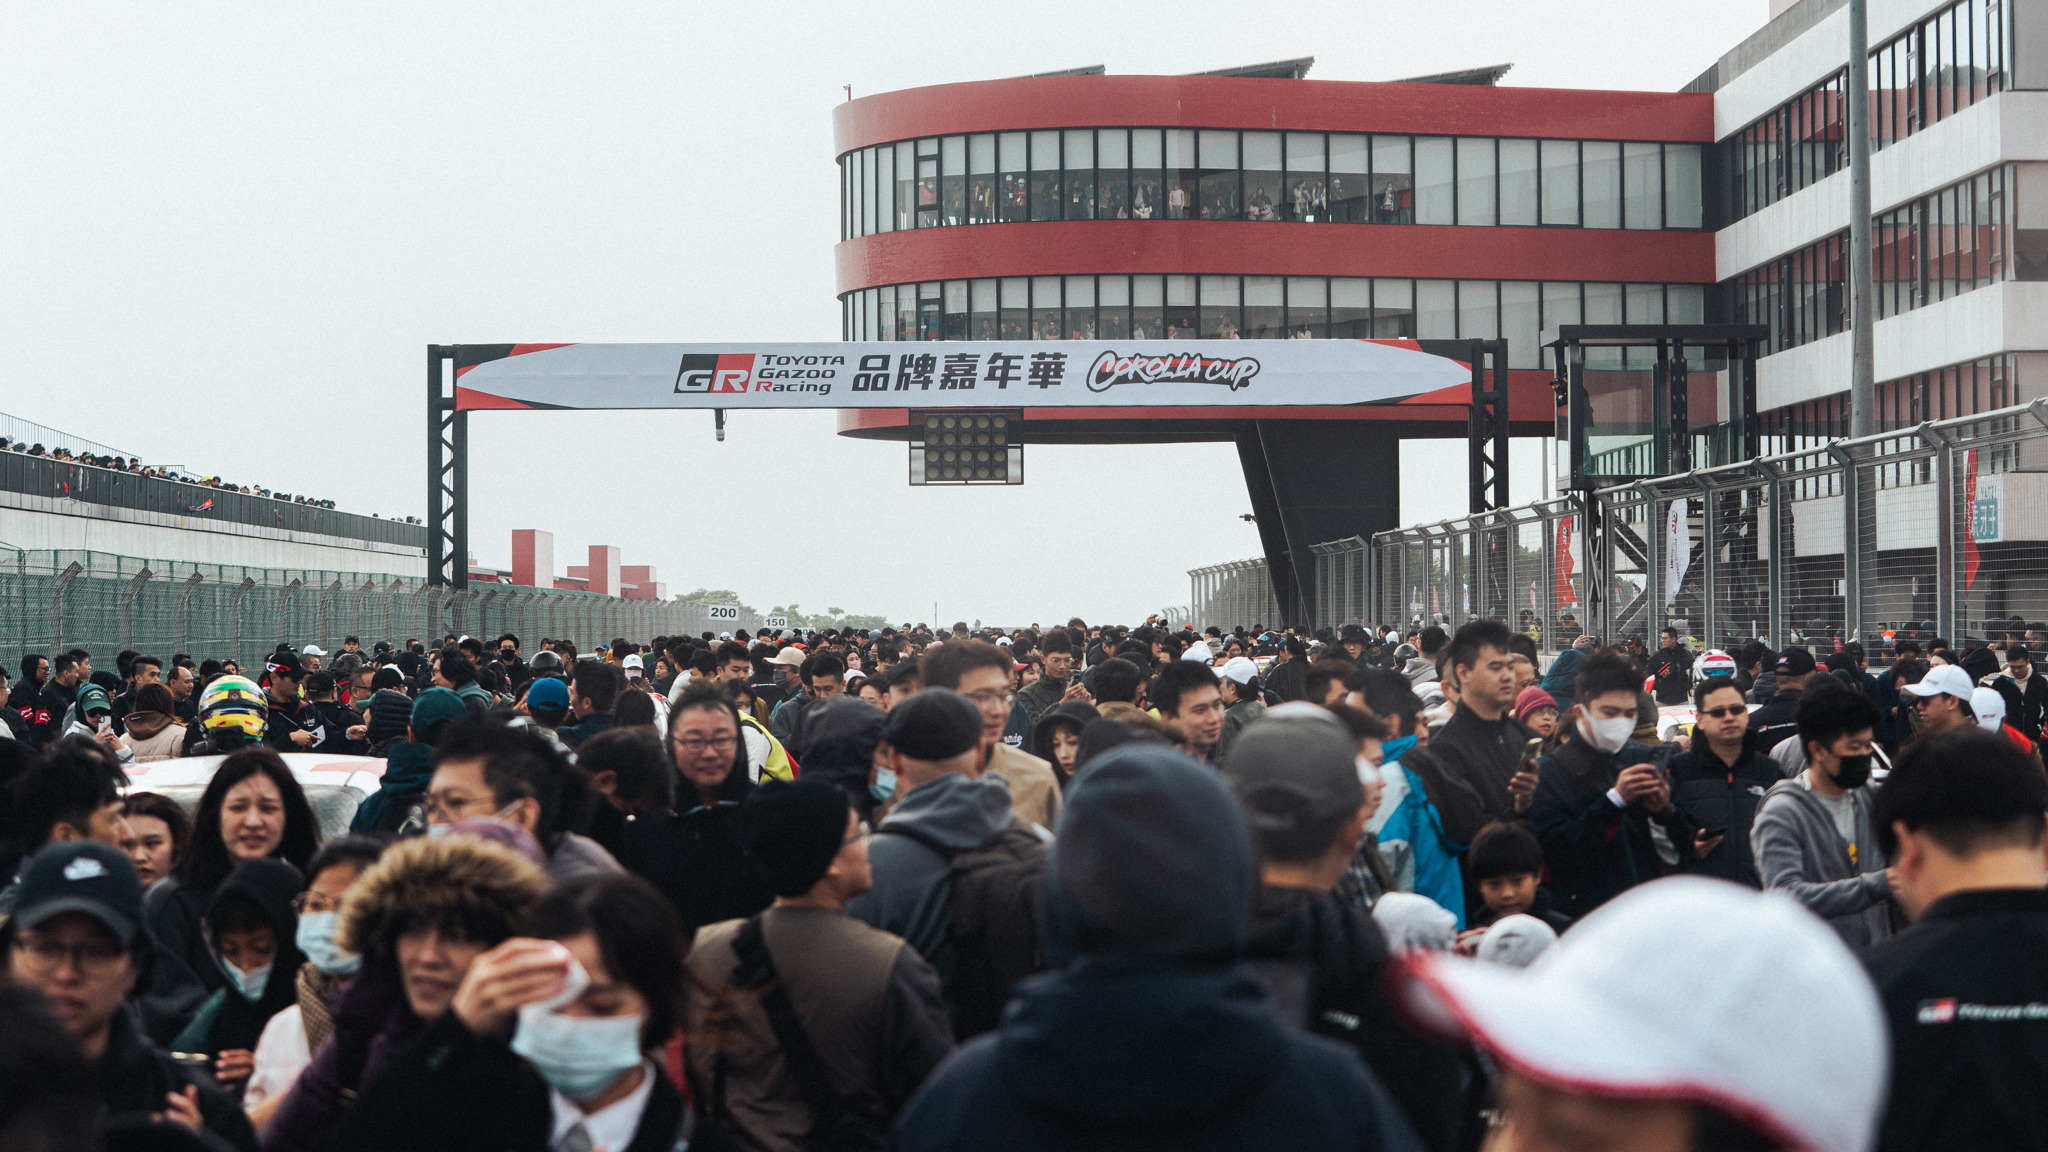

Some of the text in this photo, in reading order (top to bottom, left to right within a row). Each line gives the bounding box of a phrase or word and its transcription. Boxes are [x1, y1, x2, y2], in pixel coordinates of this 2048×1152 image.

[761, 354, 845, 366] TOYOTA
[758, 368, 836, 379] GAZOO
[851, 352, 1068, 391] 品牌嘉年華
[1087, 351, 1259, 391] COROLLA CUP
[755, 381, 832, 396] Racing
[710, 607, 737, 618] 200
[765, 618, 785, 627] 150
